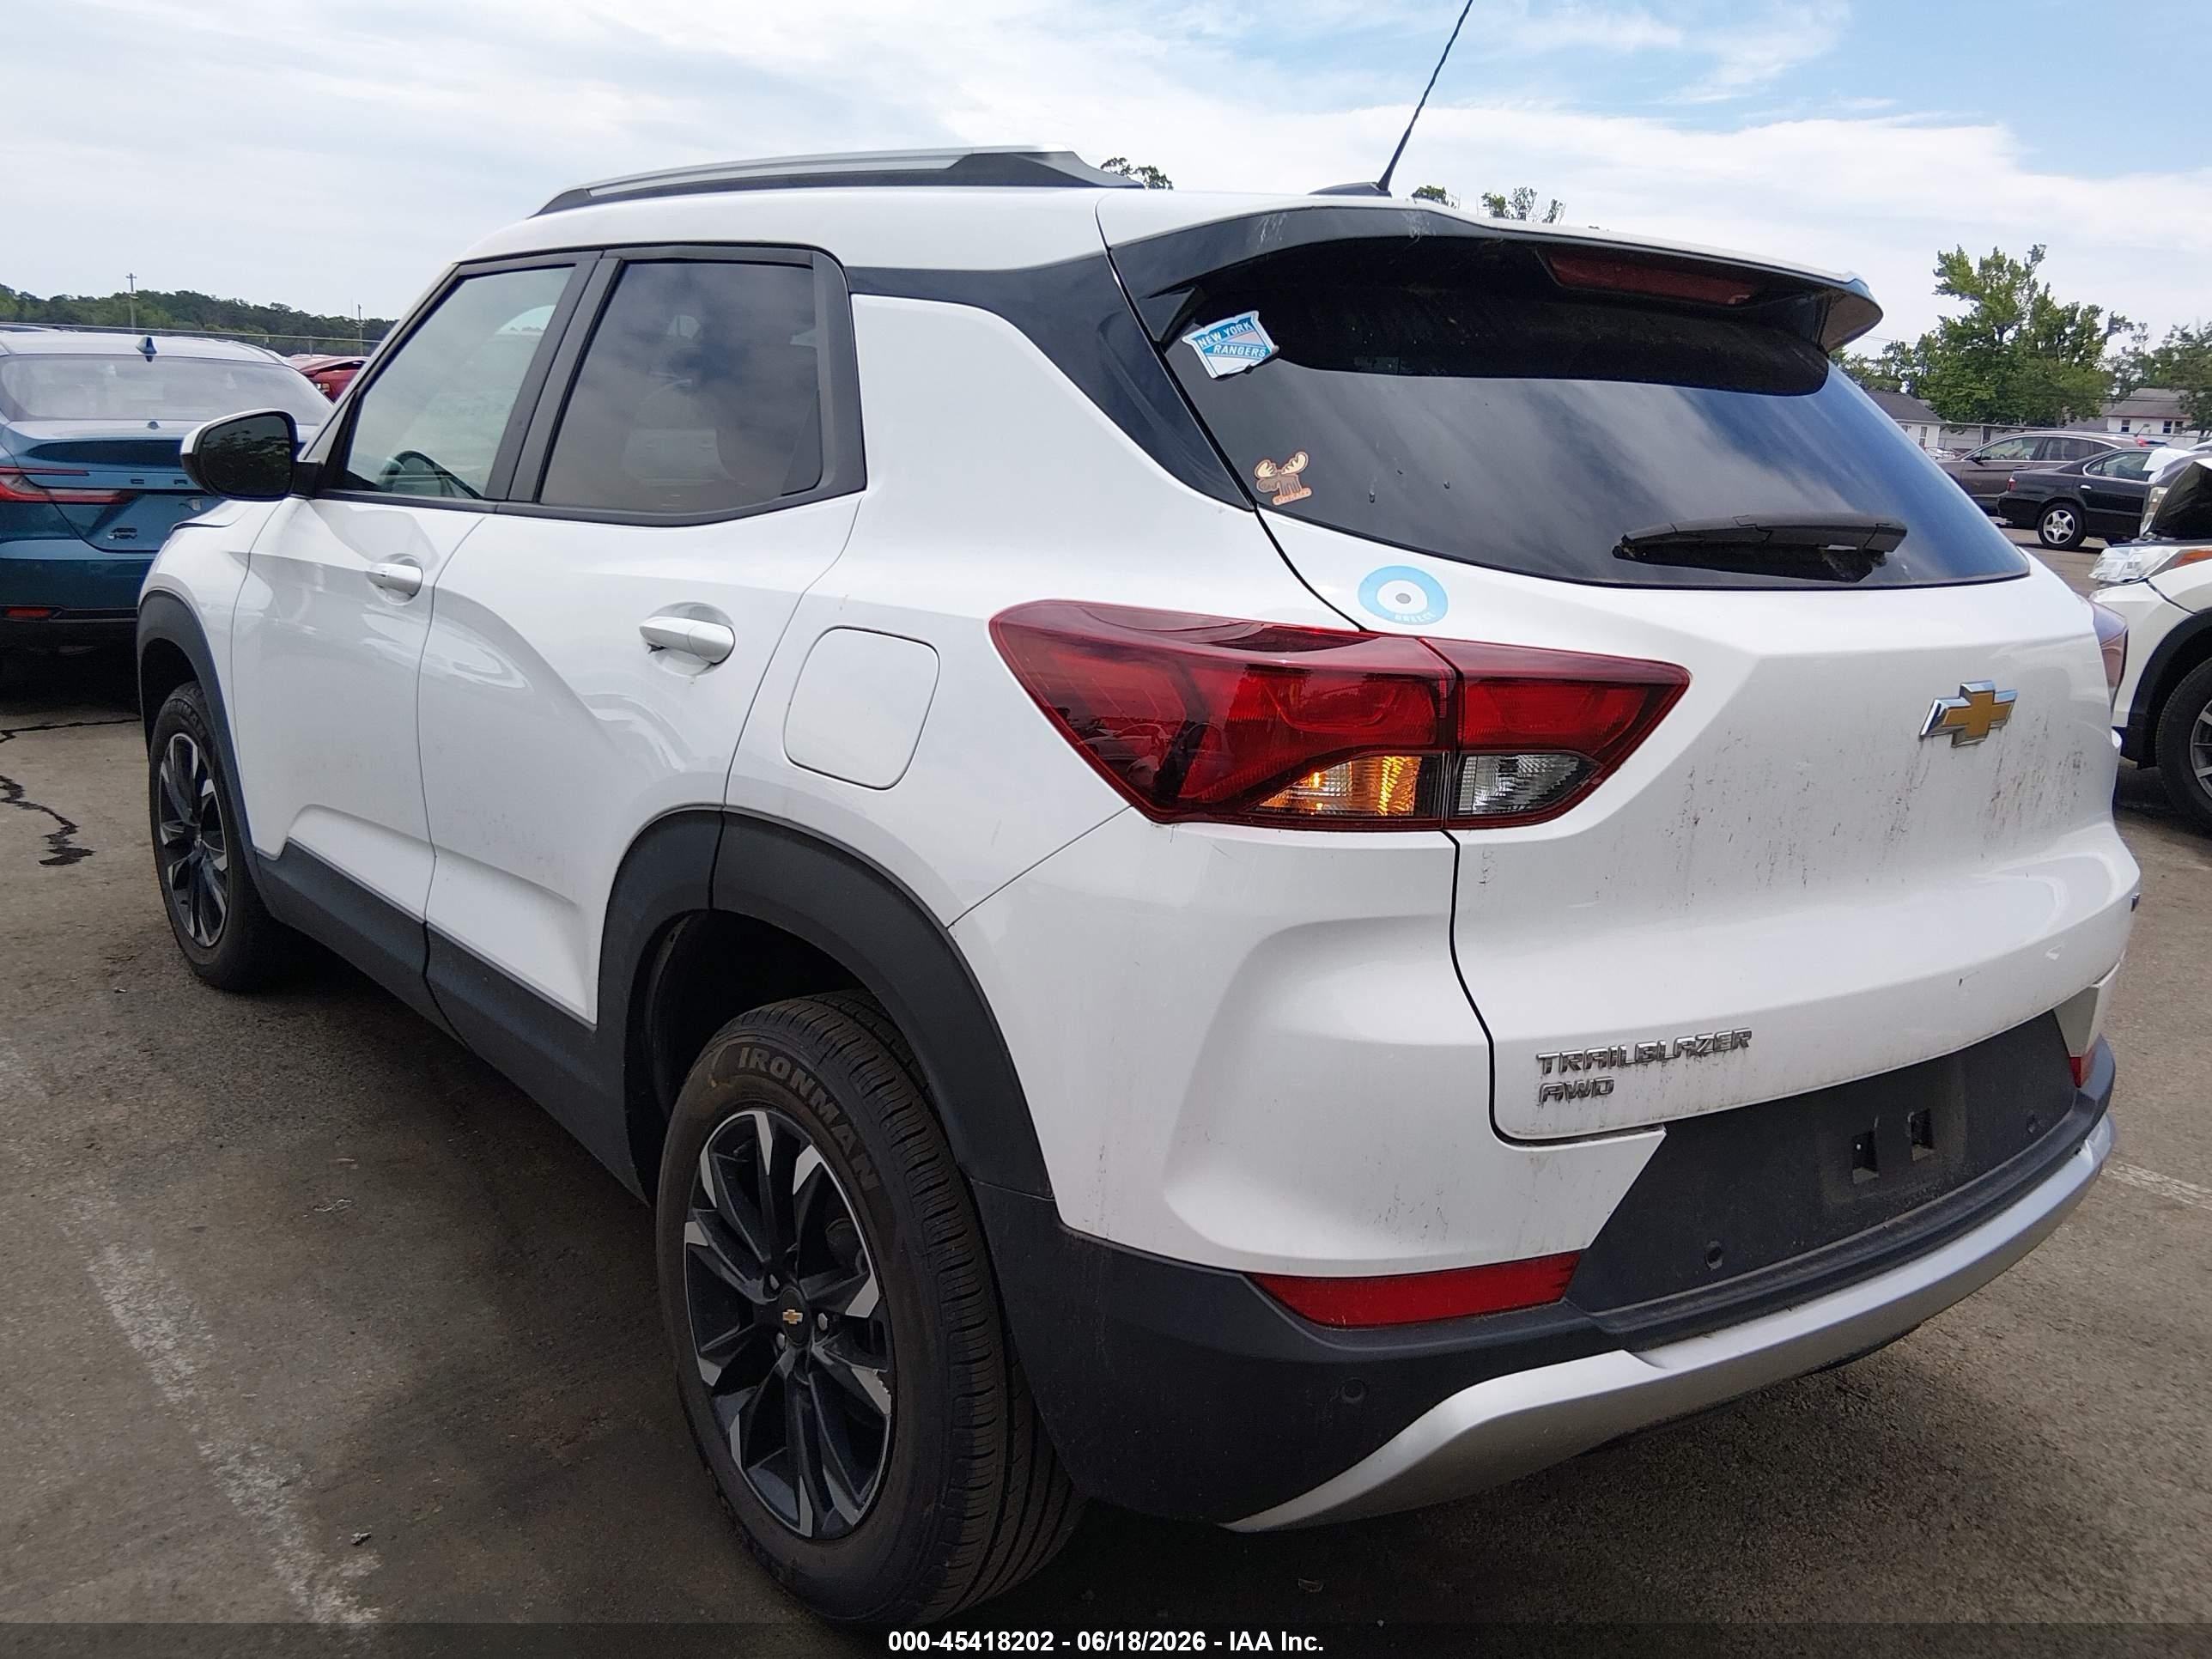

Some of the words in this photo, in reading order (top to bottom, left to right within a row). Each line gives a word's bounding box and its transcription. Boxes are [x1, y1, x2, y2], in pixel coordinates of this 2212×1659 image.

[1198, 331, 1222, 348] NEW
[1224, 320, 1253, 337] YORK
[1212, 344, 1267, 358] RANGERS
[1536, 1027, 1752, 1075] TRAILBLAZER
[1539, 1076, 1614, 1103] AWD
[738, 1046, 880, 1193] IRONMAN
